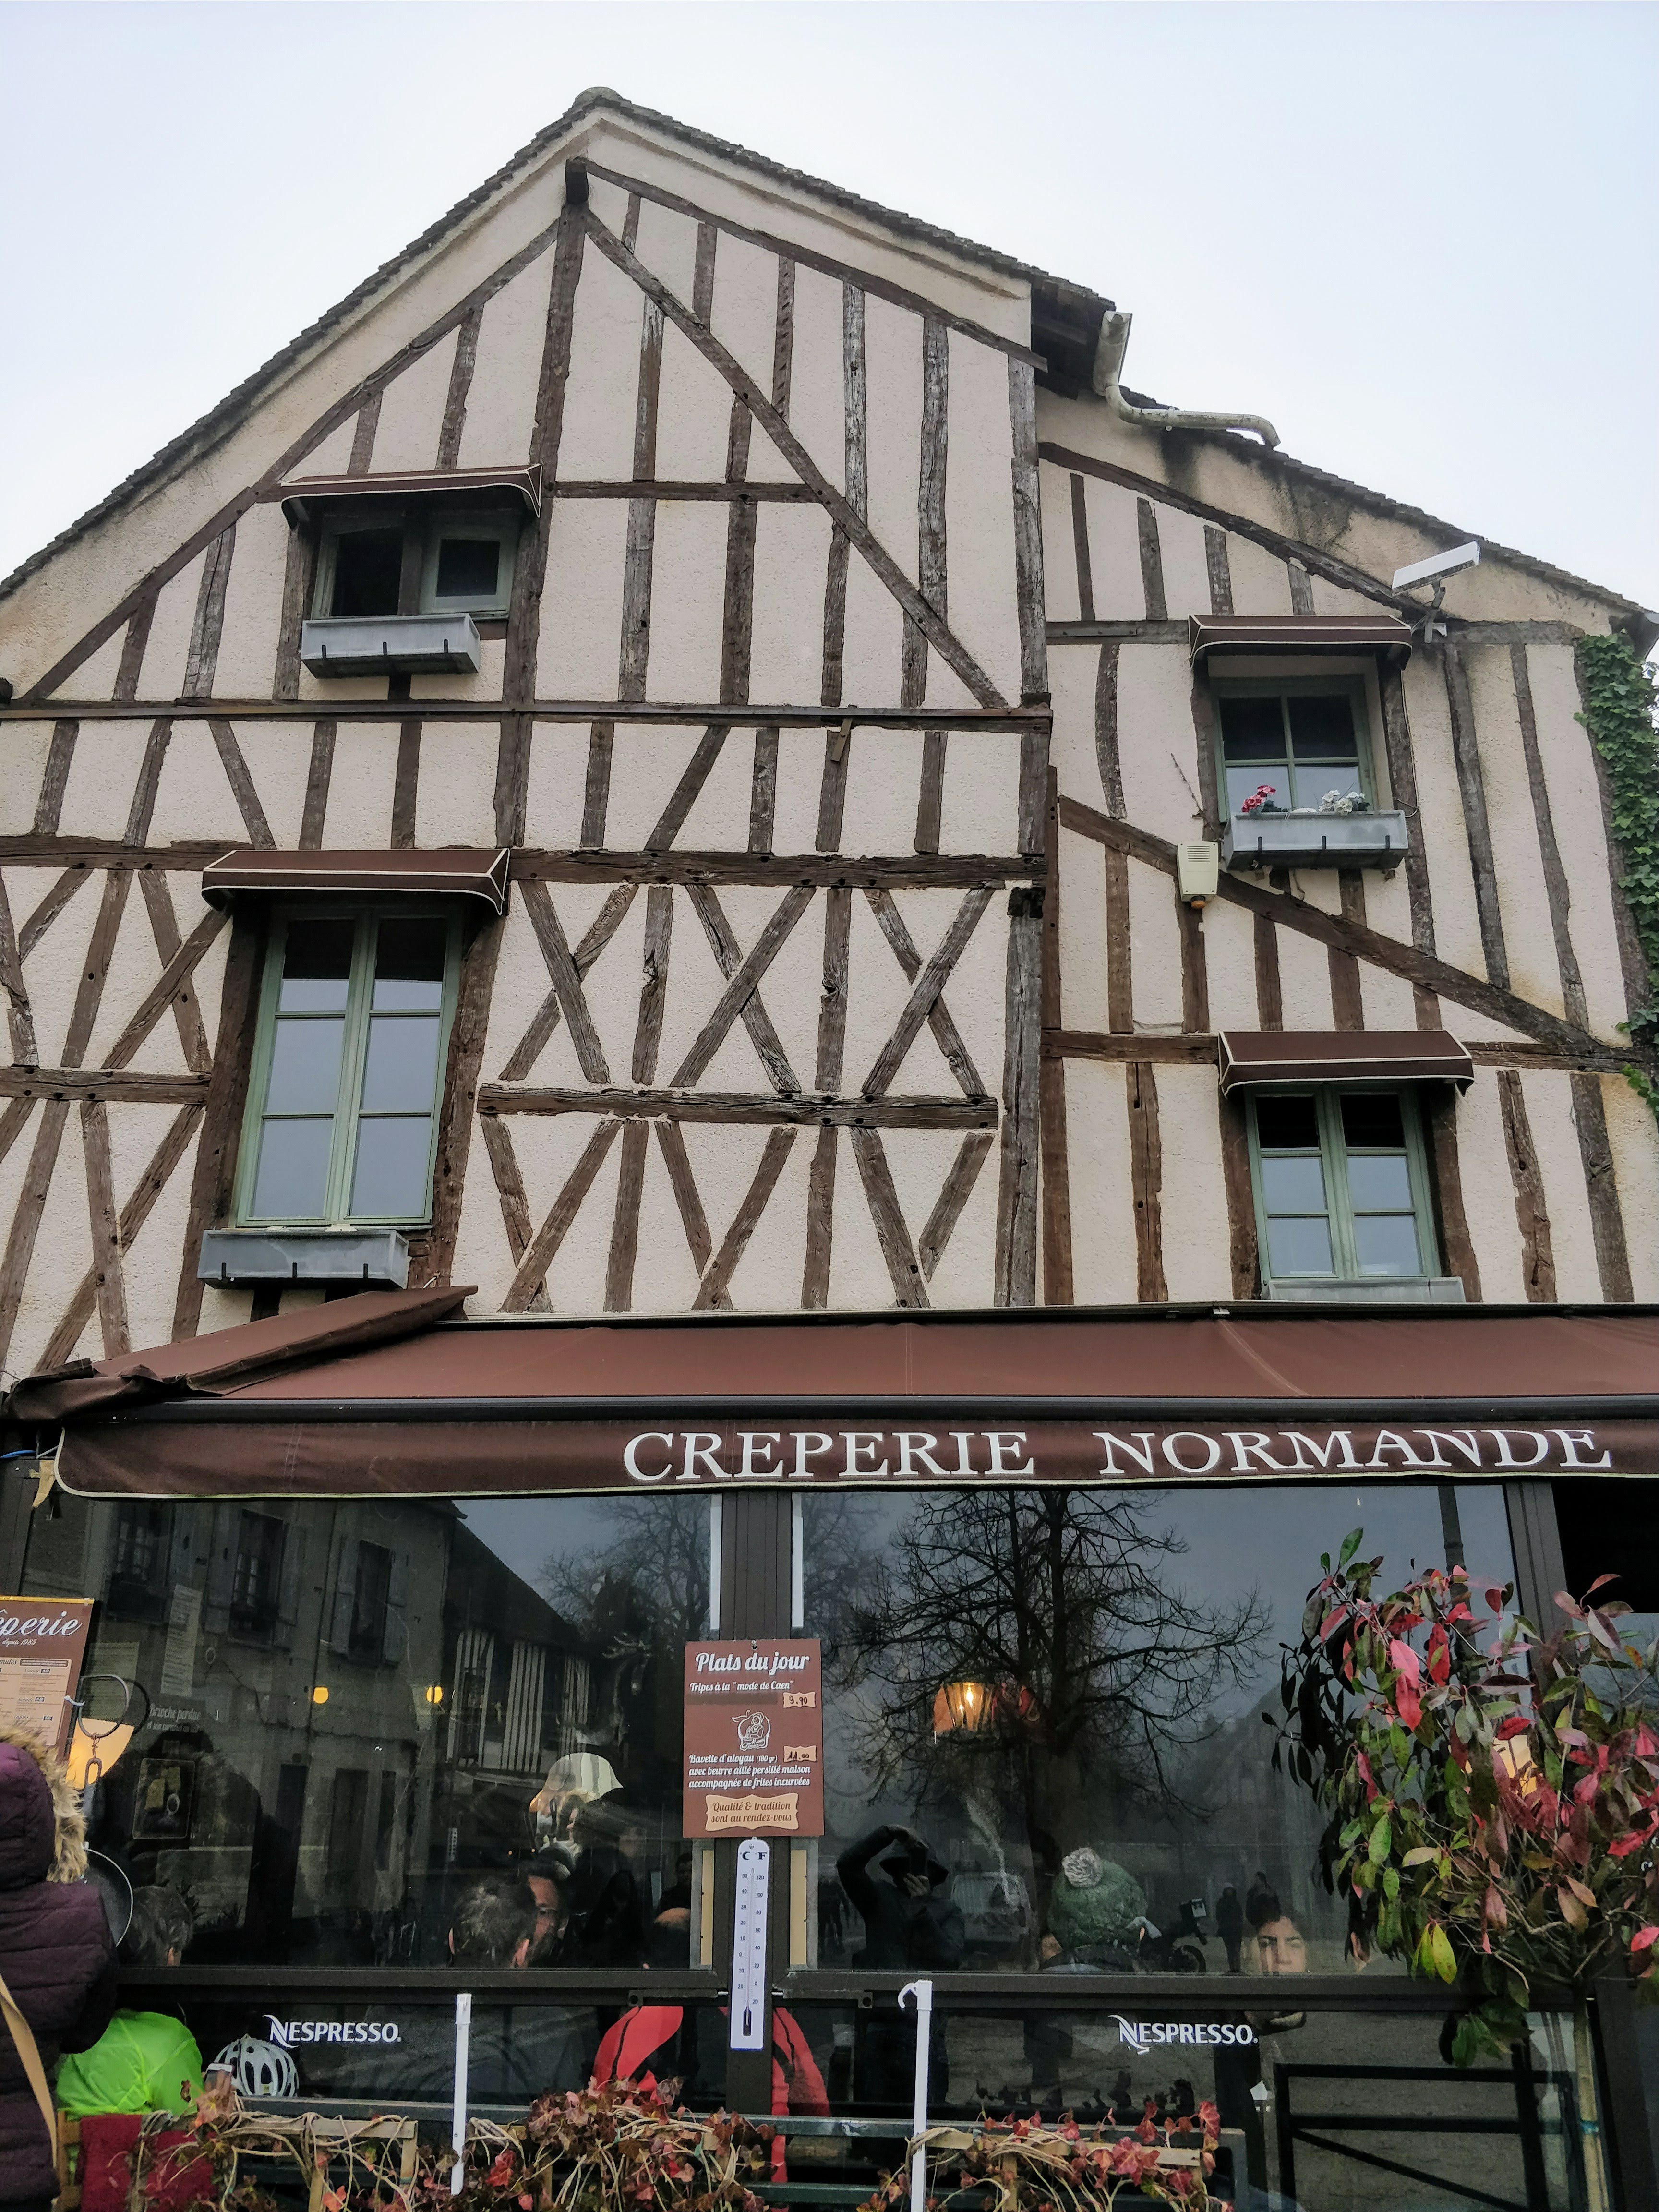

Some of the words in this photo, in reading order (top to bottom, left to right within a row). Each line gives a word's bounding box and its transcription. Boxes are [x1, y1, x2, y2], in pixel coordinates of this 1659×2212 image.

[623, 1432, 1035, 1481] CREPERIE
[1092, 1428, 1611, 1475] NORMANDE
[2, 1637, 19, 1647] depuis
[695, 1652, 741, 1671] Plats
[745, 1652, 769, 1671] du
[768, 1651, 810, 1675] jour
[690, 1683, 713, 1694] Tripes
[714, 1682, 721, 1691] à
[722, 1682, 731, 1691] la
[759, 1682, 769, 1690] de
[689, 1754, 718, 1763] Bavette
[719, 1754, 754, 1765] d'aloyau
[756, 1755, 768, 1764] (180
[769, 1755, 777, 1764] gr)
[708, 1767, 733, 1775] beurre
[751, 1765, 781, 1777] persillé
[781, 1765, 811, 1774] maison
[689, 1778, 742, 1790] accompagnée
[743, 1778, 753, 1787] de
[751, 1777, 773, 1789] frites
[774, 1776, 810, 1786] incurvées
[712, 1802, 743, 1812] Qualité
[745, 1801, 752, 1811] &
[754, 1801, 791, 1811] tradition
[711, 1814, 728, 1823] sont
[743, 1813, 792, 1822] rendez-vous
